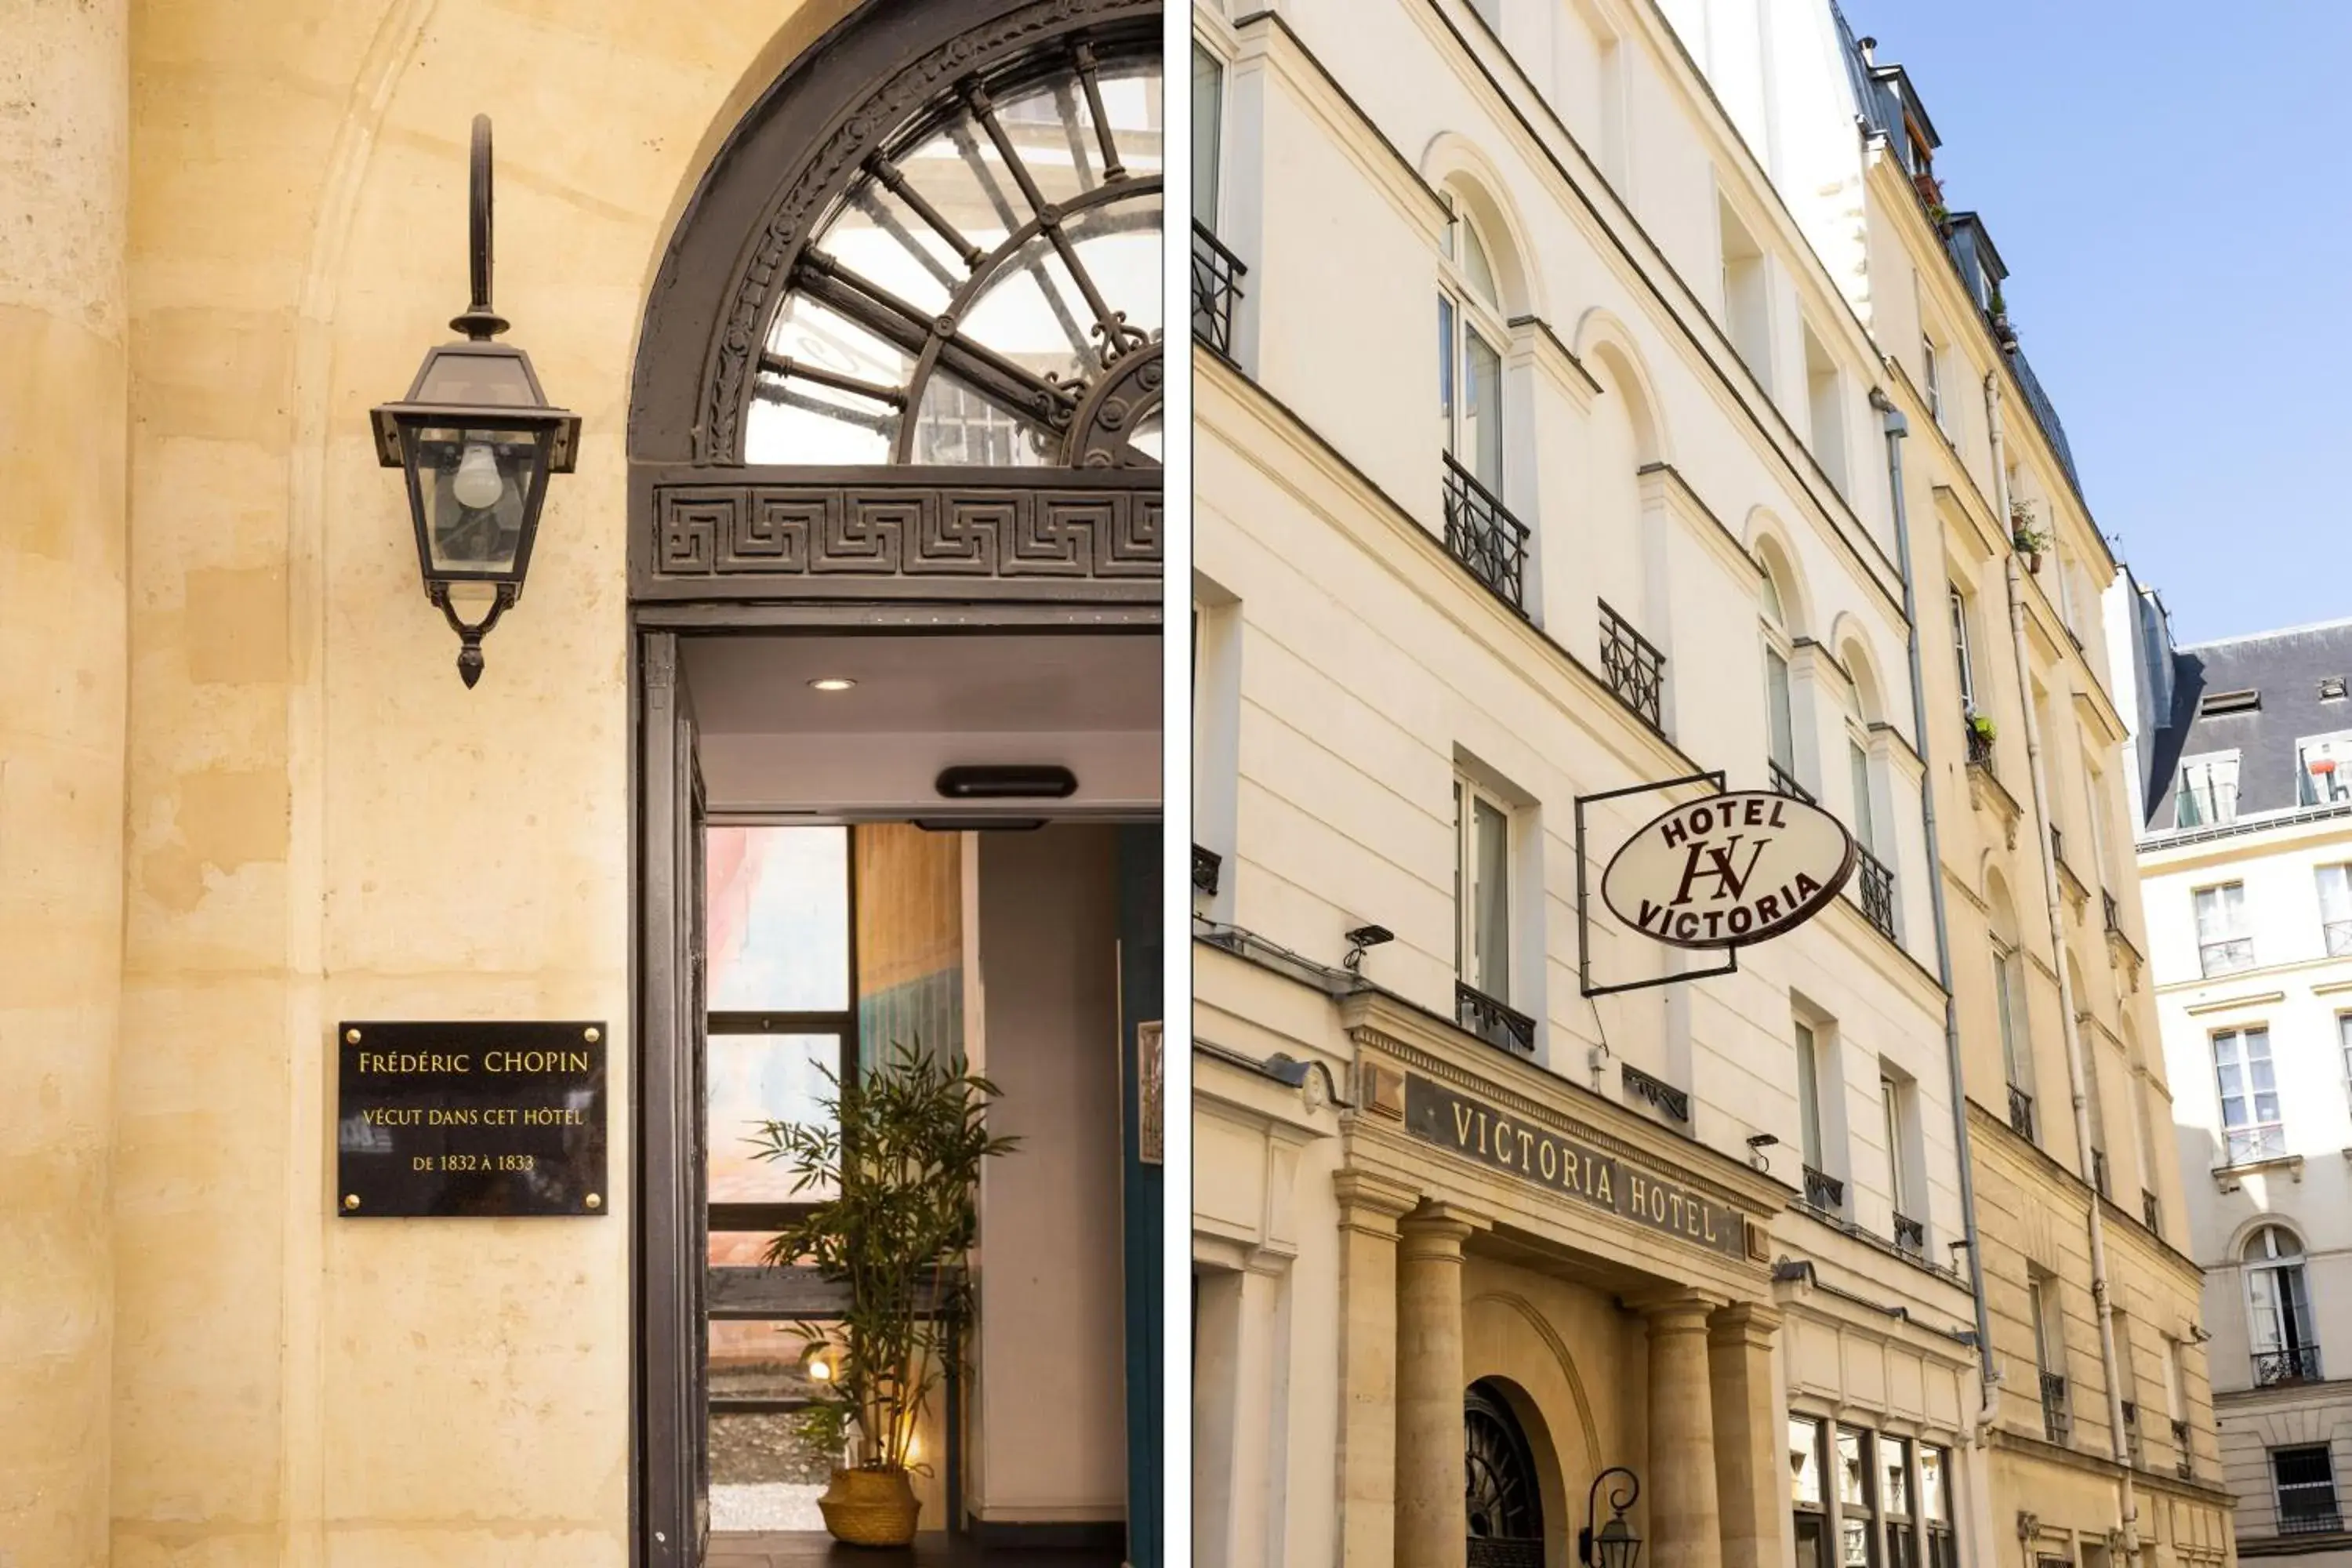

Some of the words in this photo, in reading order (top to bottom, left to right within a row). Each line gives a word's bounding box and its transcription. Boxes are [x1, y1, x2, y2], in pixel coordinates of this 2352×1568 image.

[1661, 799, 1787, 849] HOTEL
[1638, 872, 1822, 940] VICTORIA
[359, 1051, 470, 1073] FRÉDÉRIC
[485, 1051, 588, 1073] CHOPIN
[363, 1108, 423, 1126] VÉCUT
[428, 1109, 477, 1126] DANS
[484, 1109, 517, 1126] CET
[524, 1106, 584, 1126] HÔTEL
[413, 1156, 434, 1171] DE
[441, 1155, 476, 1171] 1832
[481, 1154, 492, 1171] À
[498, 1154, 534, 1171] 1833
[1452, 1102, 1614, 1204] VICTORIA
[1630, 1175, 1717, 1243] HOTEL
